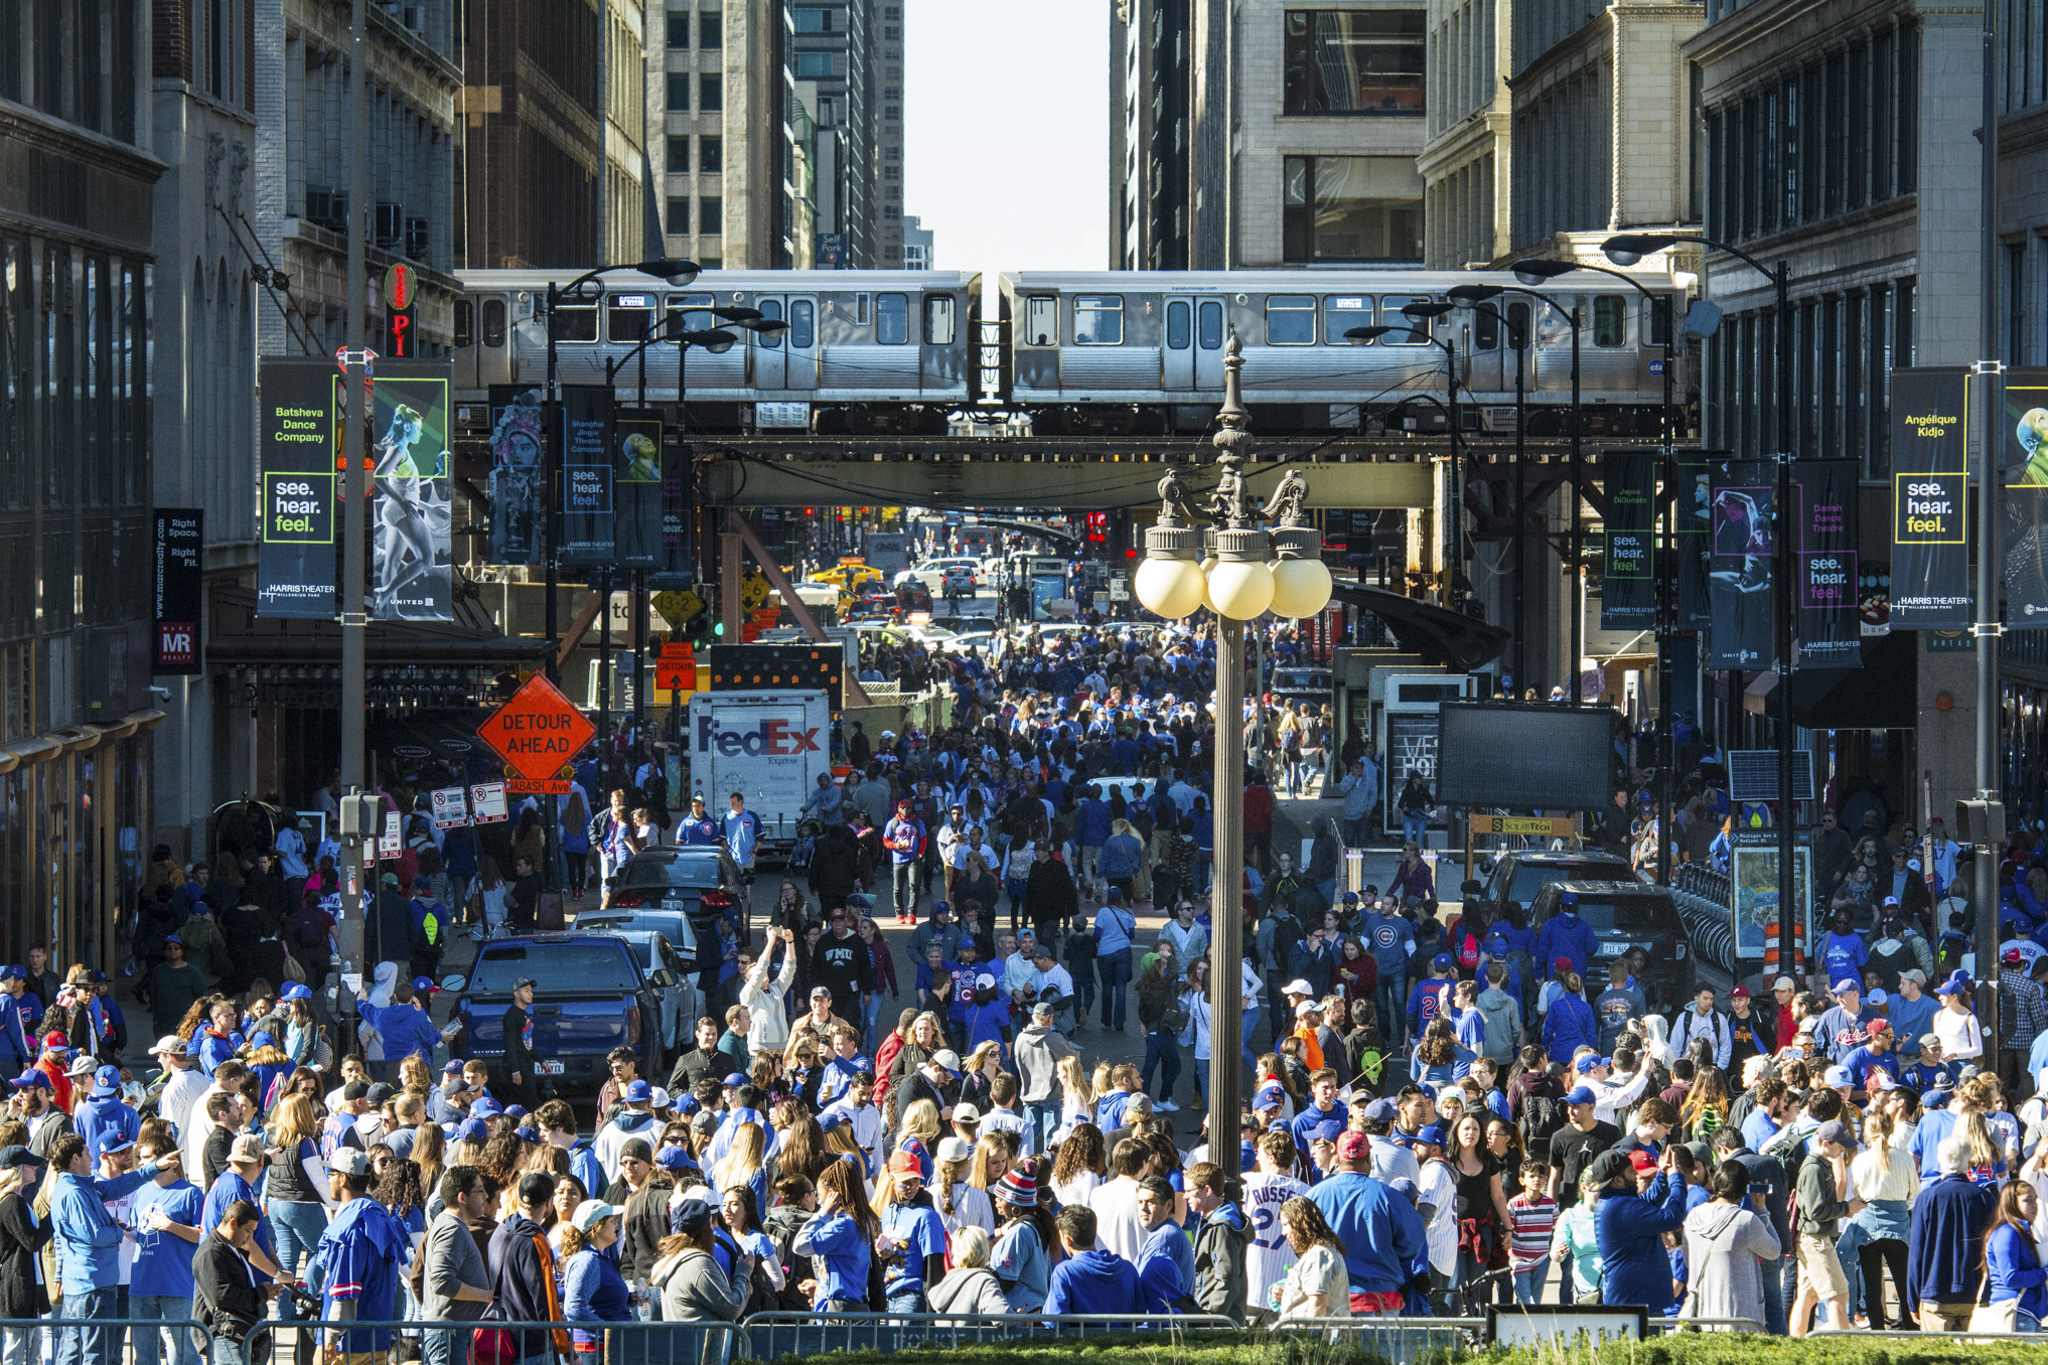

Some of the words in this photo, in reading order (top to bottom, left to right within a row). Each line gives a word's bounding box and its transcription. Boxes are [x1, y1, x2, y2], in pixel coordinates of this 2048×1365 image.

[823, 234, 840, 243] Self
[1650, 363, 1663, 371] cta
[276, 407, 324, 418] Batsheva
[283, 419, 316, 430] Dance
[572, 420, 604, 429] Shanghai
[1905, 414, 1957, 427] Angélique
[577, 429, 599, 437] Jingju
[1917, 427, 1944, 437] Kidjo
[275, 432, 324, 444] Company
[571, 446, 605, 454] Company
[572, 471, 599, 481] see.
[275, 482, 314, 495] see.
[572, 482, 603, 494] hear.
[1619, 488, 1641, 496] Joyce
[1907, 482, 1945, 496] see.
[572, 493, 599, 506] feel.
[1613, 496, 1647, 504] DiDonato
[276, 497, 320, 514] hear.
[1813, 504, 1843, 513] Danish
[1907, 498, 1952, 514] hear.
[172, 519, 196, 528] Right
[275, 515, 314, 532] feel.
[1814, 514, 1842, 522] Dance
[1812, 524, 1844, 532] Theatre
[1907, 515, 1946, 533] feel.
[168, 528, 199, 538] Space.
[1613, 536, 1640, 546] see.
[171, 548, 196, 557] Right
[1613, 547, 1644, 559] hear.
[156, 518, 166, 619] www.marcrealty.com
[184, 559, 199, 567] Fit.
[1613, 559, 1640, 571] feel.
[1810, 558, 1842, 570] see.
[1810, 571, 1847, 584] hear.
[269, 584, 300, 592] HARRIS
[301, 584, 335, 593] THEATER
[1810, 585, 1842, 599] feel.
[1901, 597, 1931, 605] HARRIS
[1931, 597, 1967, 605] THEATER
[162, 633, 191, 653] MR
[660, 662, 693, 671] DETOUR
[503, 714, 572, 730] DETOUR
[698, 716, 821, 757] FedEx
[506, 738, 570, 753] AHEAD
[768, 757, 798, 766] Express
[508, 780, 545, 791] WABASH
[551, 781, 569, 792] Ave
[824, 947, 852, 962] WMU
[629, 1087, 637, 1095] C
[486, 1099, 494, 1107] C
